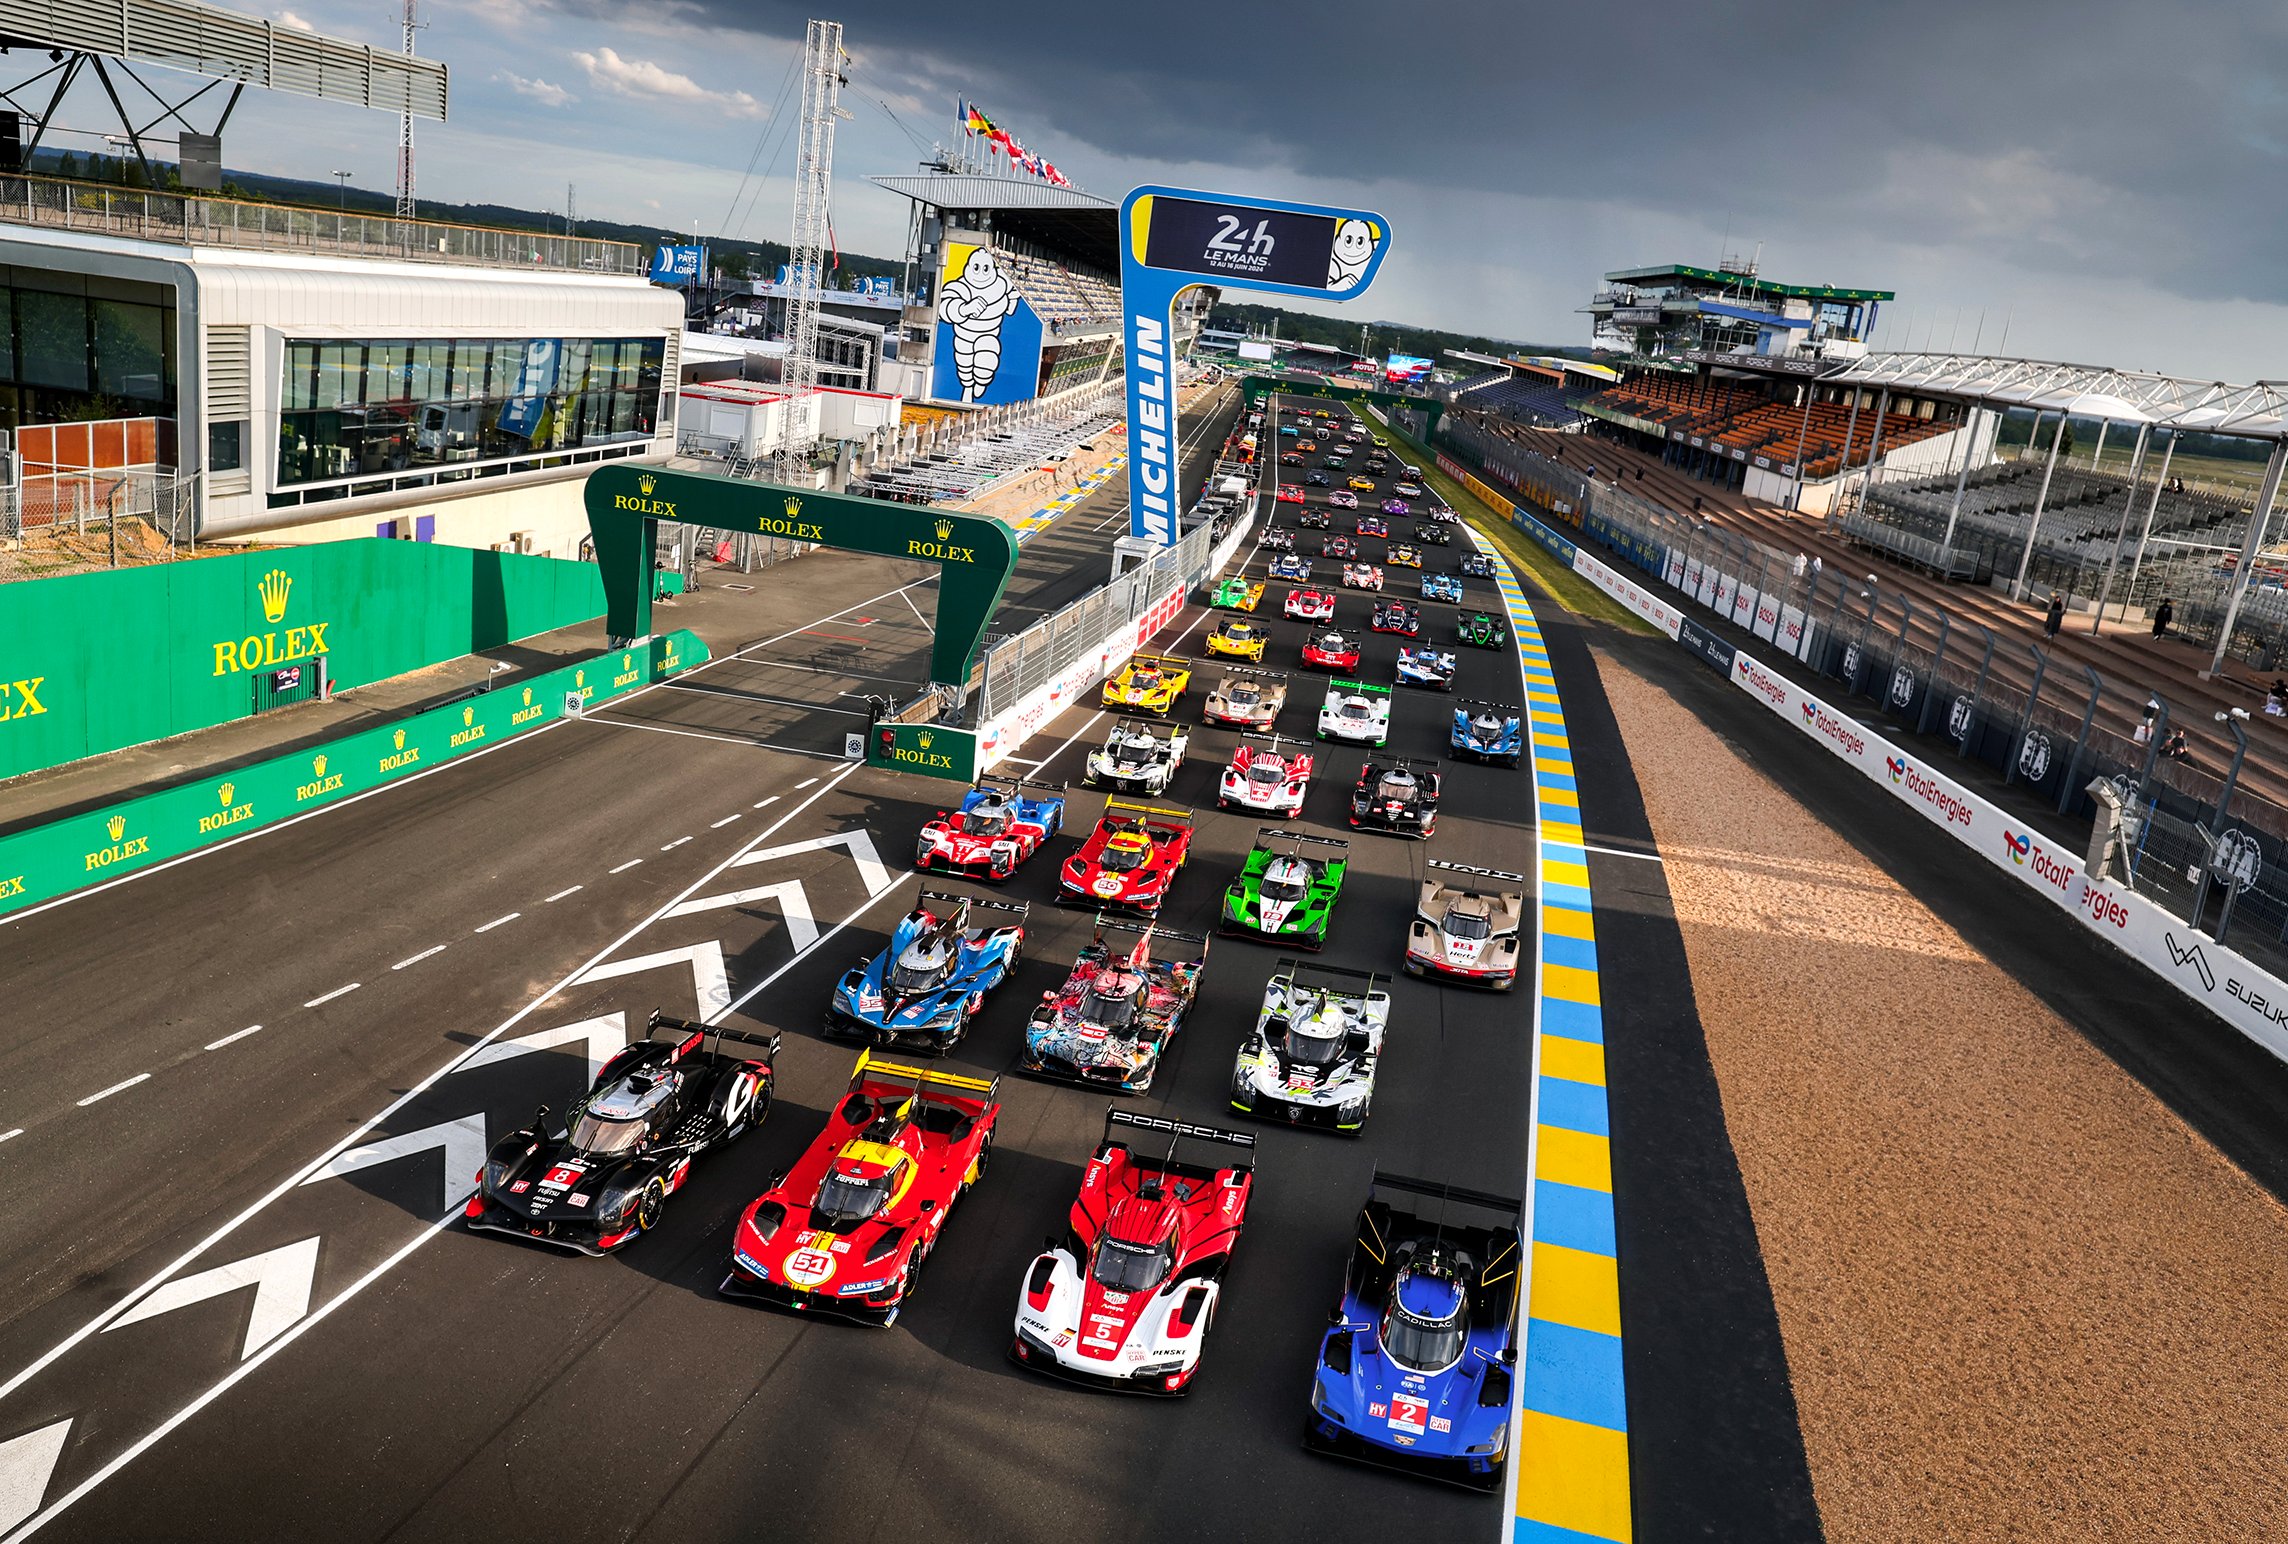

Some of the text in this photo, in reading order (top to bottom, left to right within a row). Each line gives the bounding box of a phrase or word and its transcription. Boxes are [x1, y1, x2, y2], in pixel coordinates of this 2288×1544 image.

[1207, 214, 1275, 255] 24h
[677, 253, 697, 263] PAYS
[1203, 249, 1268, 266] LE MANS
[674, 265, 697, 275] LOIRE
[1686, 352, 1707, 361] PORSCHE
[1715, 355, 1739, 365] PORSCHE
[1745, 358, 1773, 368] PORSCHE
[1352, 363, 1376, 372] MOTUL
[1784, 362, 1816, 373] PORSCHE
[1135, 314, 1169, 547] MICHELIN
[615, 495, 676, 517] ROLEX
[759, 517, 823, 540] ROLEX
[908, 540, 974, 563] ROLEX
[1673, 562, 1684, 576] BOSC
[1758, 607, 1776, 626] BOSCH
[1786, 620, 1801, 640] BOSC
[213, 623, 329, 675] ROLEX
[657, 654, 680, 672] ROLEX
[613, 668, 639, 688] ROLEX
[1749, 667, 1786, 704] TotalEnergies
[512, 703, 543, 726] ROLEX
[451, 724, 486, 747] ROLEX
[1815, 709, 1865, 756] TotalEnergies
[380, 747, 419, 772] ROLEX
[894, 748, 952, 768] ROLEX
[297, 773, 343, 801] ROLEX
[1904, 767, 1973, 826] TotalEnergies
[200, 803, 254, 834] ROLEX
[86, 836, 149, 871] ROLEX
[1099, 881, 1117, 890] 50
[2029, 845, 2128, 929] TotalEergies
[1449, 951, 1477, 960] Hertz
[680, 1031, 705, 1056] DENSO
[1289, 1077, 1314, 1088] 93
[1112, 1111, 1254, 1144] PORSCHE
[554, 1170, 570, 1182] 8
[835, 1173, 870, 1187] Ferrari
[1086, 1164, 1102, 1188] Ansys
[512, 1181, 528, 1192] HY
[538, 1187, 561, 1197] FUJITSU
[570, 1197, 587, 1206] CAR
[1222, 1190, 1237, 1215] Ansys
[795, 1234, 813, 1244] HY
[1106, 1238, 1156, 1254] PORSCHE
[832, 1244, 849, 1253] CAR
[739, 1253, 758, 1269] ADLER
[794, 1255, 824, 1273] 51
[1101, 1303, 1124, 1312] Ansys
[1021, 1316, 1051, 1333] PENSKE
[1397, 1310, 1452, 1329] CADILLAC
[1053, 1333, 1070, 1347] HY
[1095, 1324, 1110, 1340] 5
[1370, 1402, 1387, 1417] HY
[1400, 1404, 1417, 1423] 2
[1430, 1422, 1450, 1432] CAR
